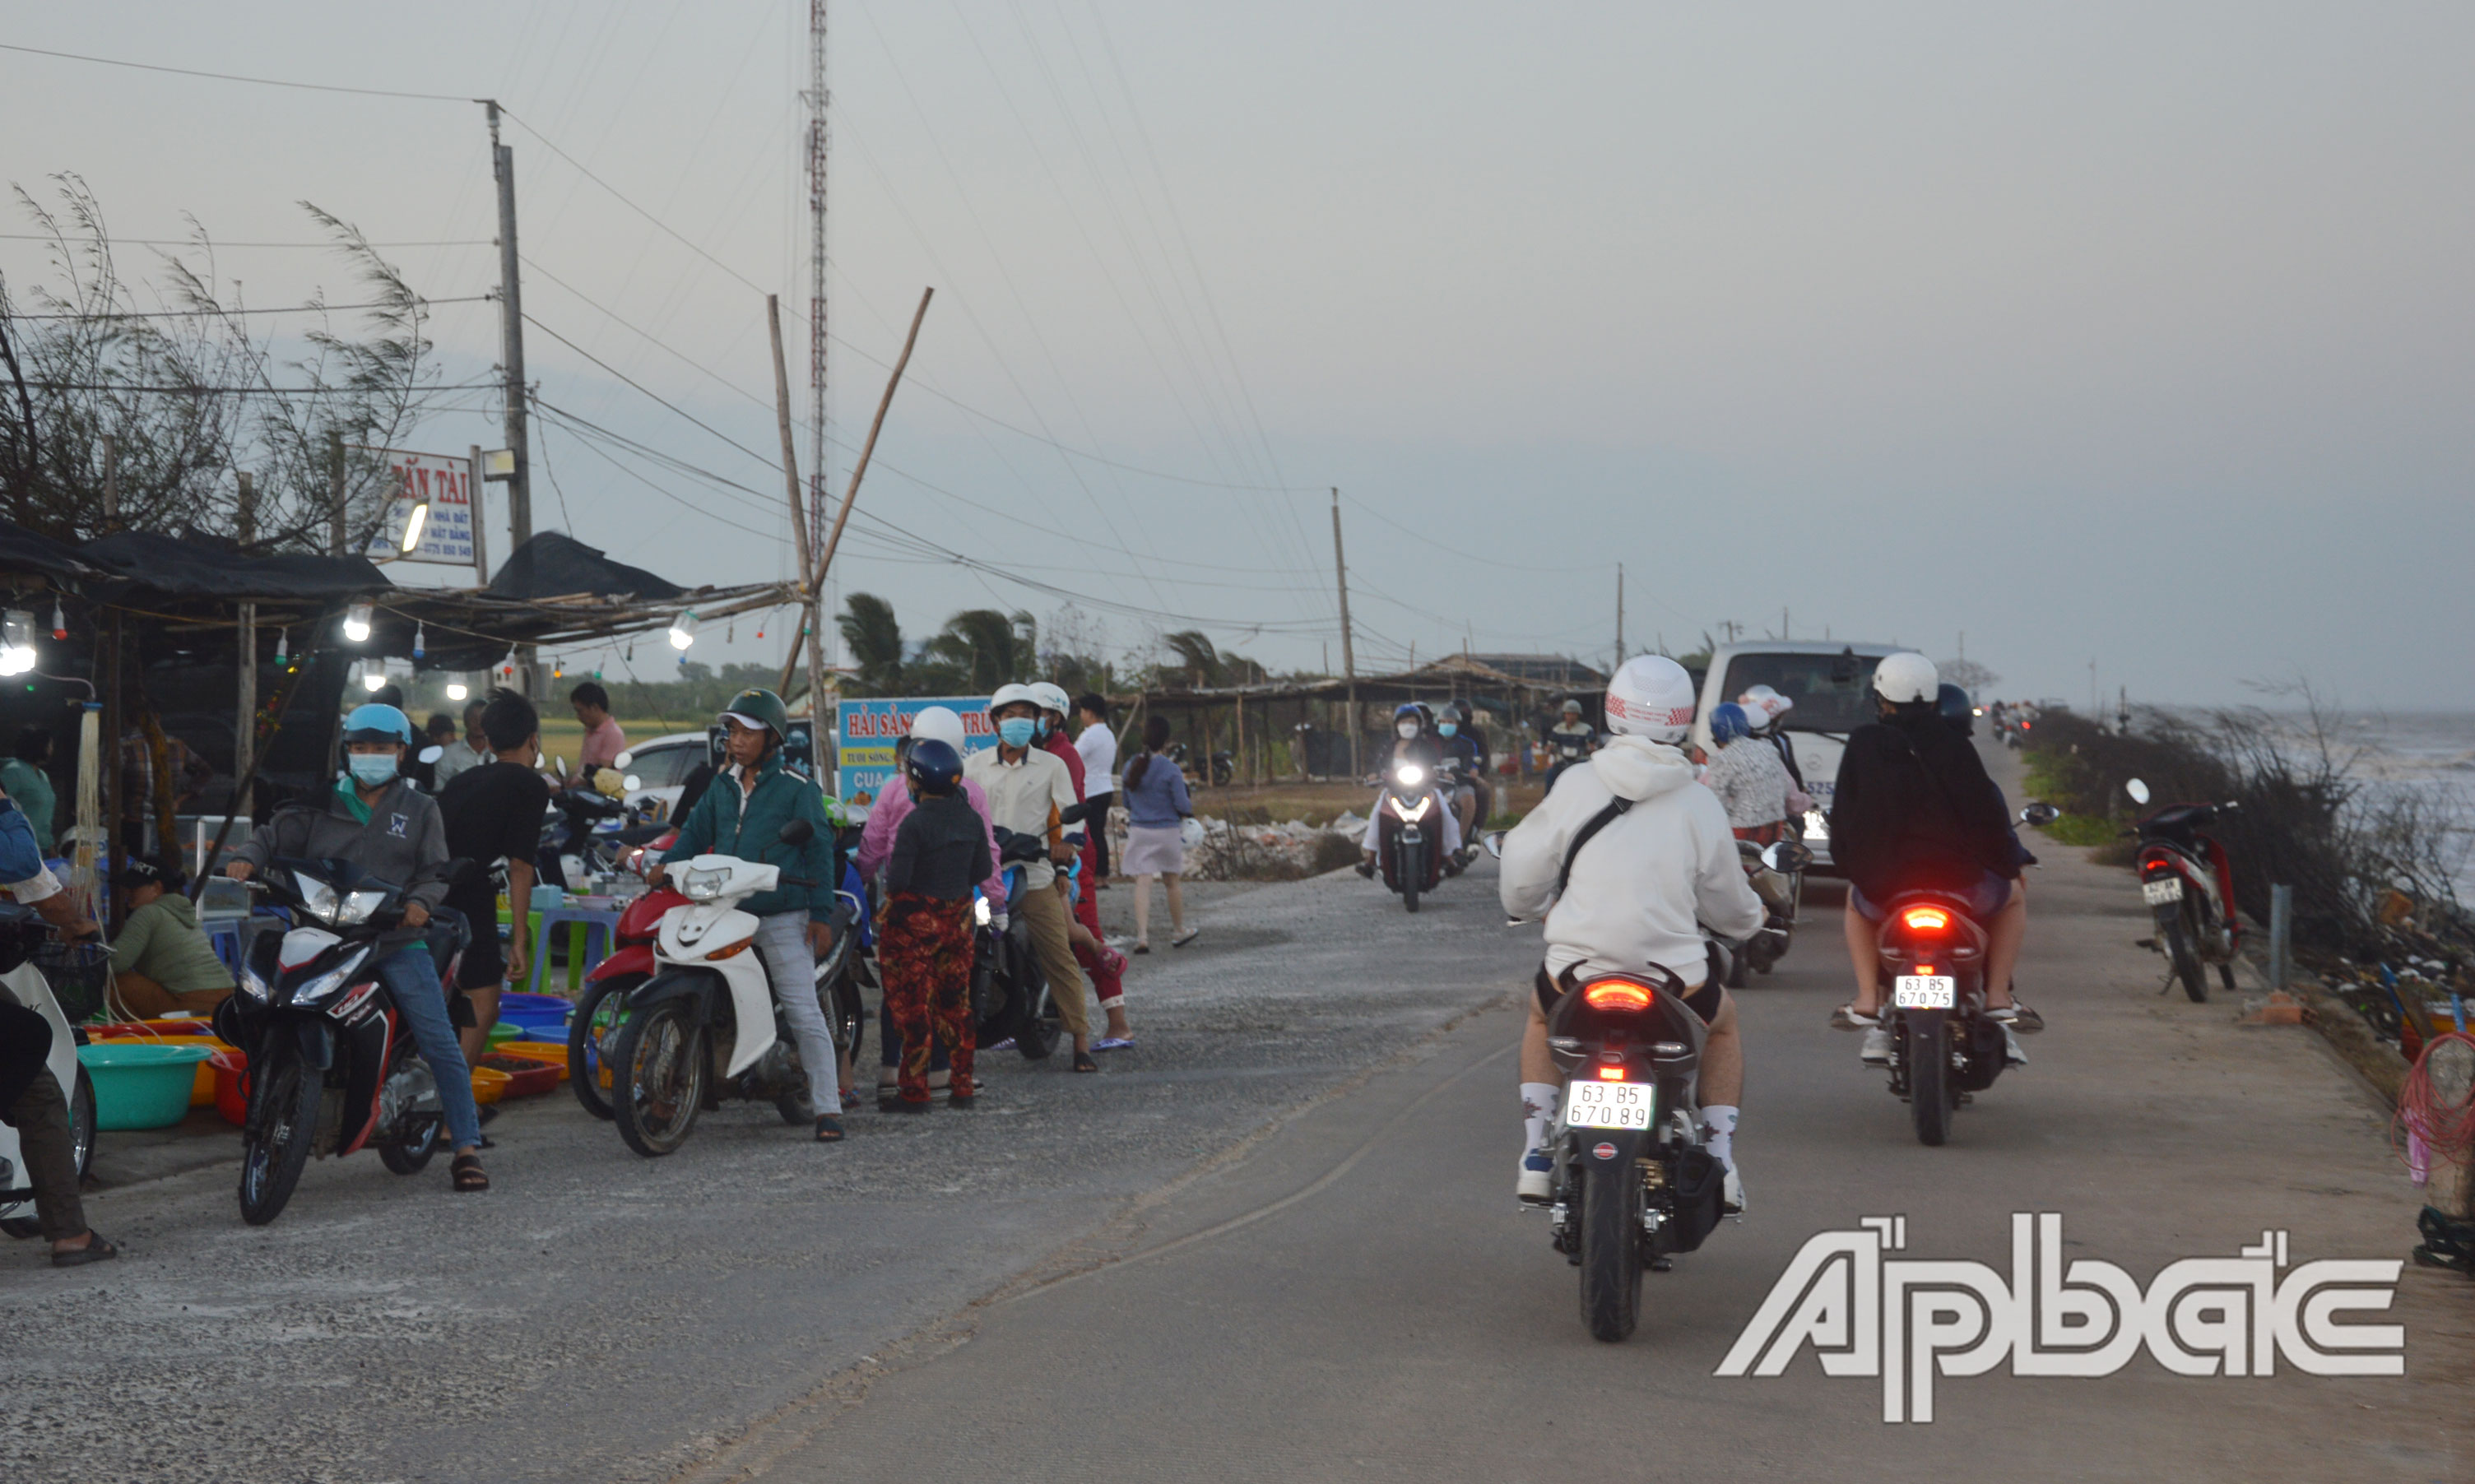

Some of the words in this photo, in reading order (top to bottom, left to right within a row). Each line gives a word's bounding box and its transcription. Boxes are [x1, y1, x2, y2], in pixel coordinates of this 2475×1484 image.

[435, 461, 468, 504] TÀI
[848, 704, 877, 737] HẢI
[853, 772, 885, 789] CUA
[1905, 978, 1920, 990] 63
[1929, 978, 1944, 991] B5
[1582, 1085, 1604, 1103] 63
[1616, 1087, 1639, 1105] B5
